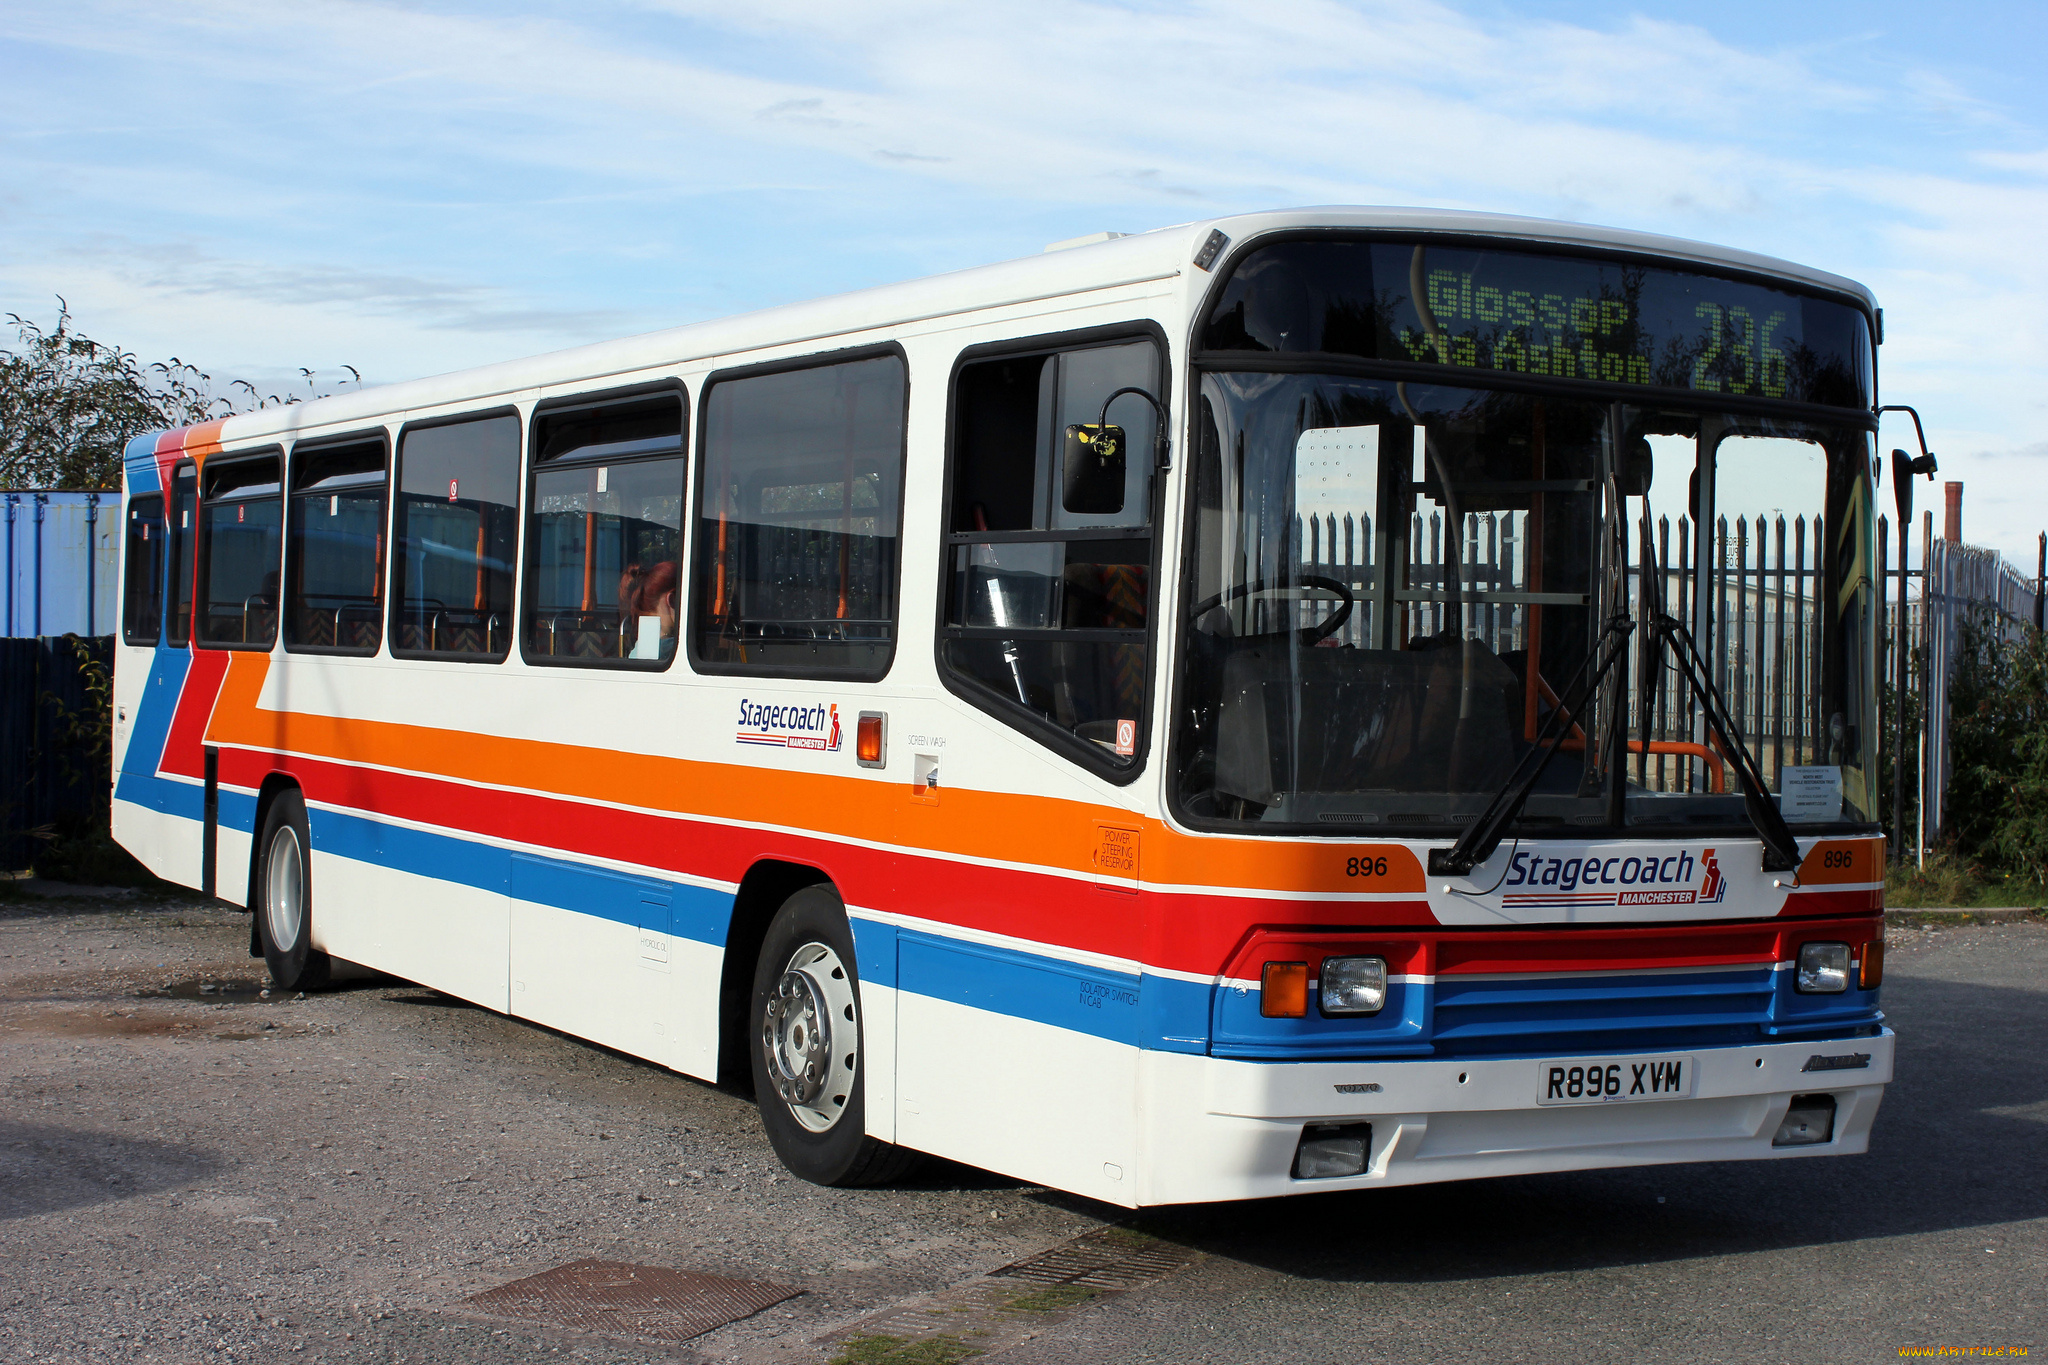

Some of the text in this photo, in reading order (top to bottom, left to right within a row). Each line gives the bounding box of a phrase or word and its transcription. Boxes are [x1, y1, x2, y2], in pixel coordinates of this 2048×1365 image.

[1494, 330, 1650, 385] Ashton
[1695, 302, 1786, 398] 236
[738, 699, 826, 732] Stagecoach
[788, 737, 826, 749] MANCHESTER
[907, 734, 947, 747] SCREEN WASH
[1105, 830, 1130, 844] POWER
[1102, 843, 1133, 858] STEERING
[1824, 850, 1853, 868] 896
[1100, 855, 1134, 871] RESERVOIR
[1346, 856, 1388, 877] 896
[1506, 850, 1694, 890] Stagecoach
[1621, 892, 1693, 904] MANCHESTER
[1080, 981, 1139, 1006] ISOLATOR SWITCH
[1087, 995, 1102, 1008] CAB
[1333, 1083, 1380, 1093] VOLVO
[1548, 1061, 1682, 1099] R896 XVM
